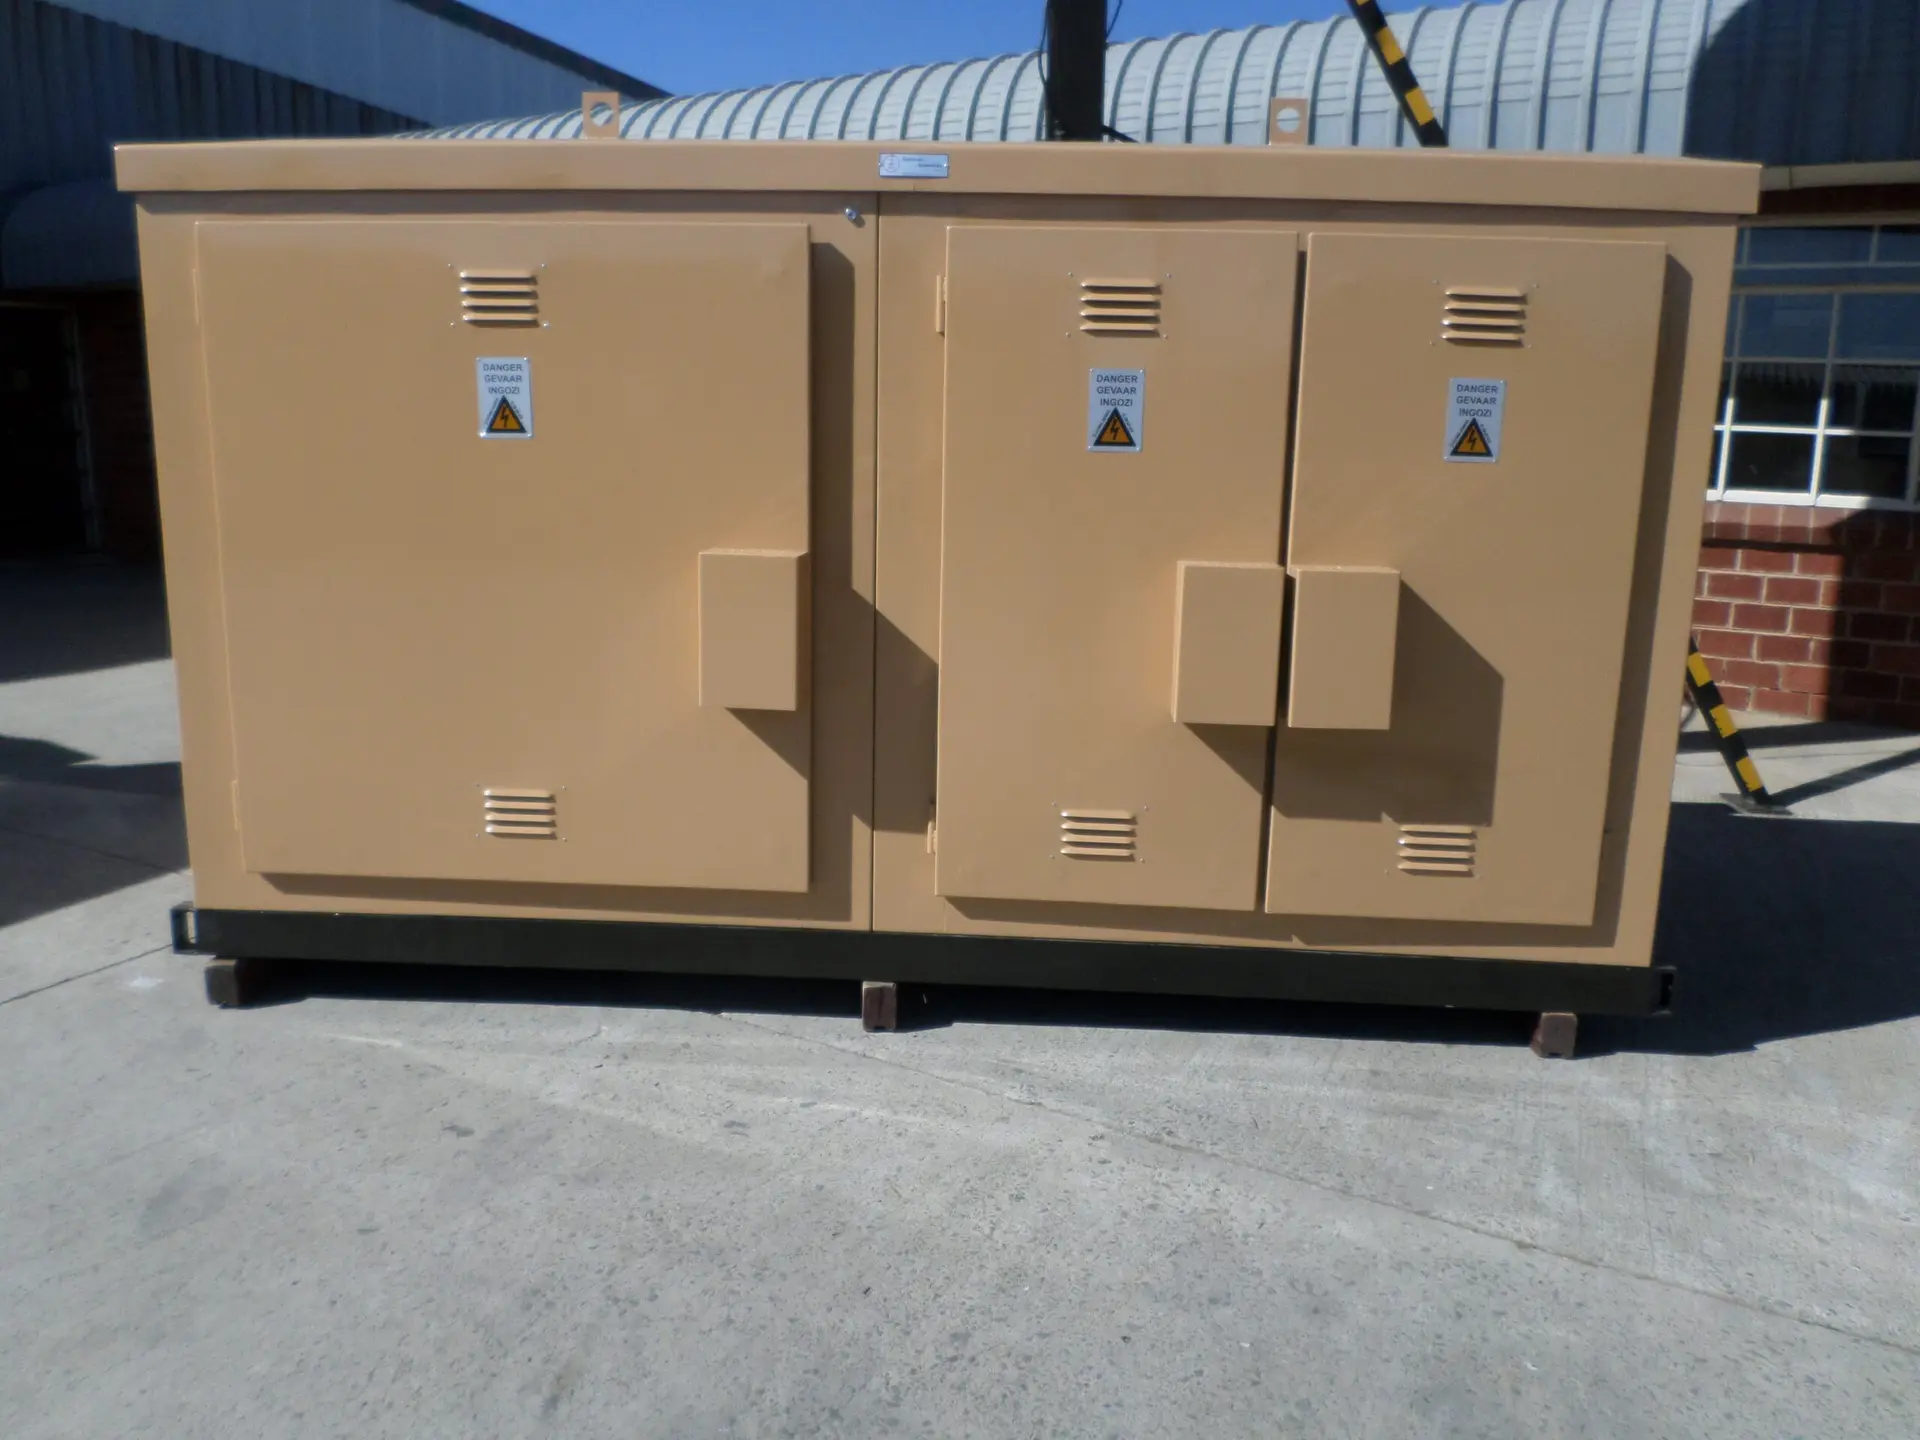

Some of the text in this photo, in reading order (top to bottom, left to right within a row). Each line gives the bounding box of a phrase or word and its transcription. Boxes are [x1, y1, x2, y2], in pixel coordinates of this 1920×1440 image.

[483, 363, 522, 372] DANGER
[484, 374, 522, 383] GEVAAR
[1096, 374, 1138, 383] DANGER
[488, 386, 520, 395] INGOZI
[1096, 386, 1137, 395] GEVAAR
[1456, 384, 1498, 394] DANGER
[1100, 398, 1133, 407] INGOZI
[1456, 395, 1497, 405] GEVAAR
[1459, 407, 1492, 417] INGOZI
